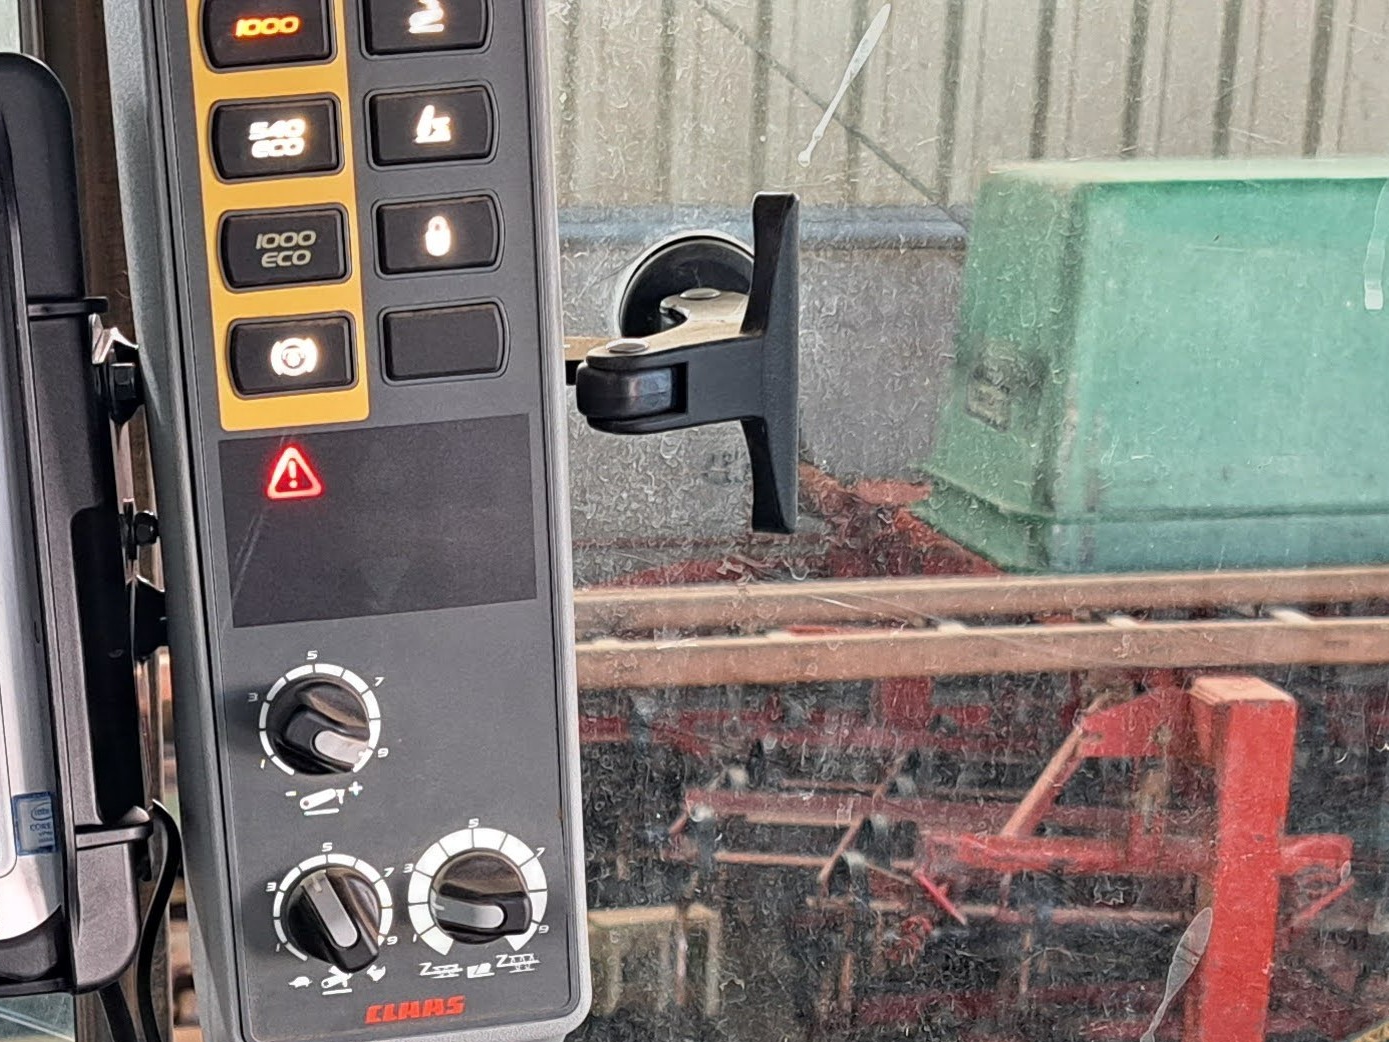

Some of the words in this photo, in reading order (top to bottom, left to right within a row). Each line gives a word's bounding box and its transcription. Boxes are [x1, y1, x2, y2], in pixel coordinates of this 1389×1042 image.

[235, 16, 301, 38] 1000
[248, 118, 306, 140] 540
[255, 230, 317, 250] 1000
[261, 250, 312, 268] ECO
[307, 650, 318, 660] 5
[378, 748, 390, 758] 9
[468, 818, 480, 828] 5
[322, 842, 333, 852] 5
[265, 882, 277, 892] 3
[538, 925, 550, 935] 9
[386, 935, 398, 945] 9
[365, 996, 466, 1024] CLAAS
